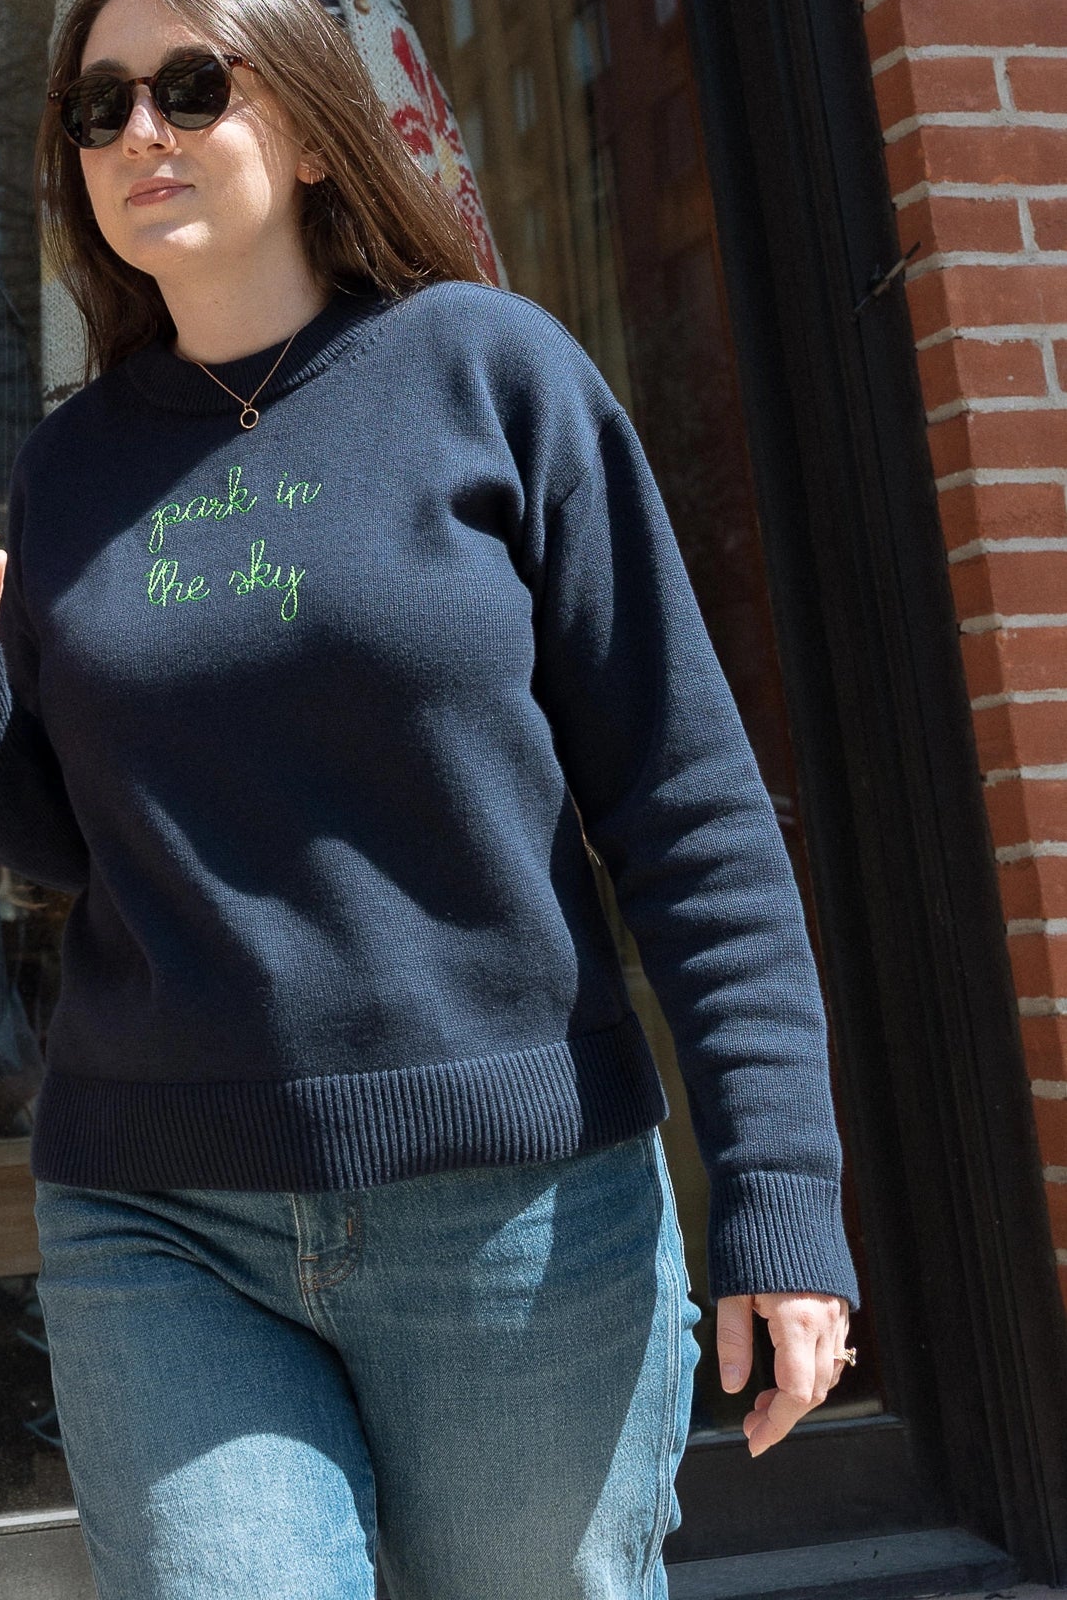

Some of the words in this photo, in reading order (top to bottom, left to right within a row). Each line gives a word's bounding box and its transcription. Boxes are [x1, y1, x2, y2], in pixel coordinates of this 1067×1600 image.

[147, 465, 257, 554] park
[276, 471, 322, 510] in
[145, 558, 210, 607] the
[228, 539, 306, 622] sky
